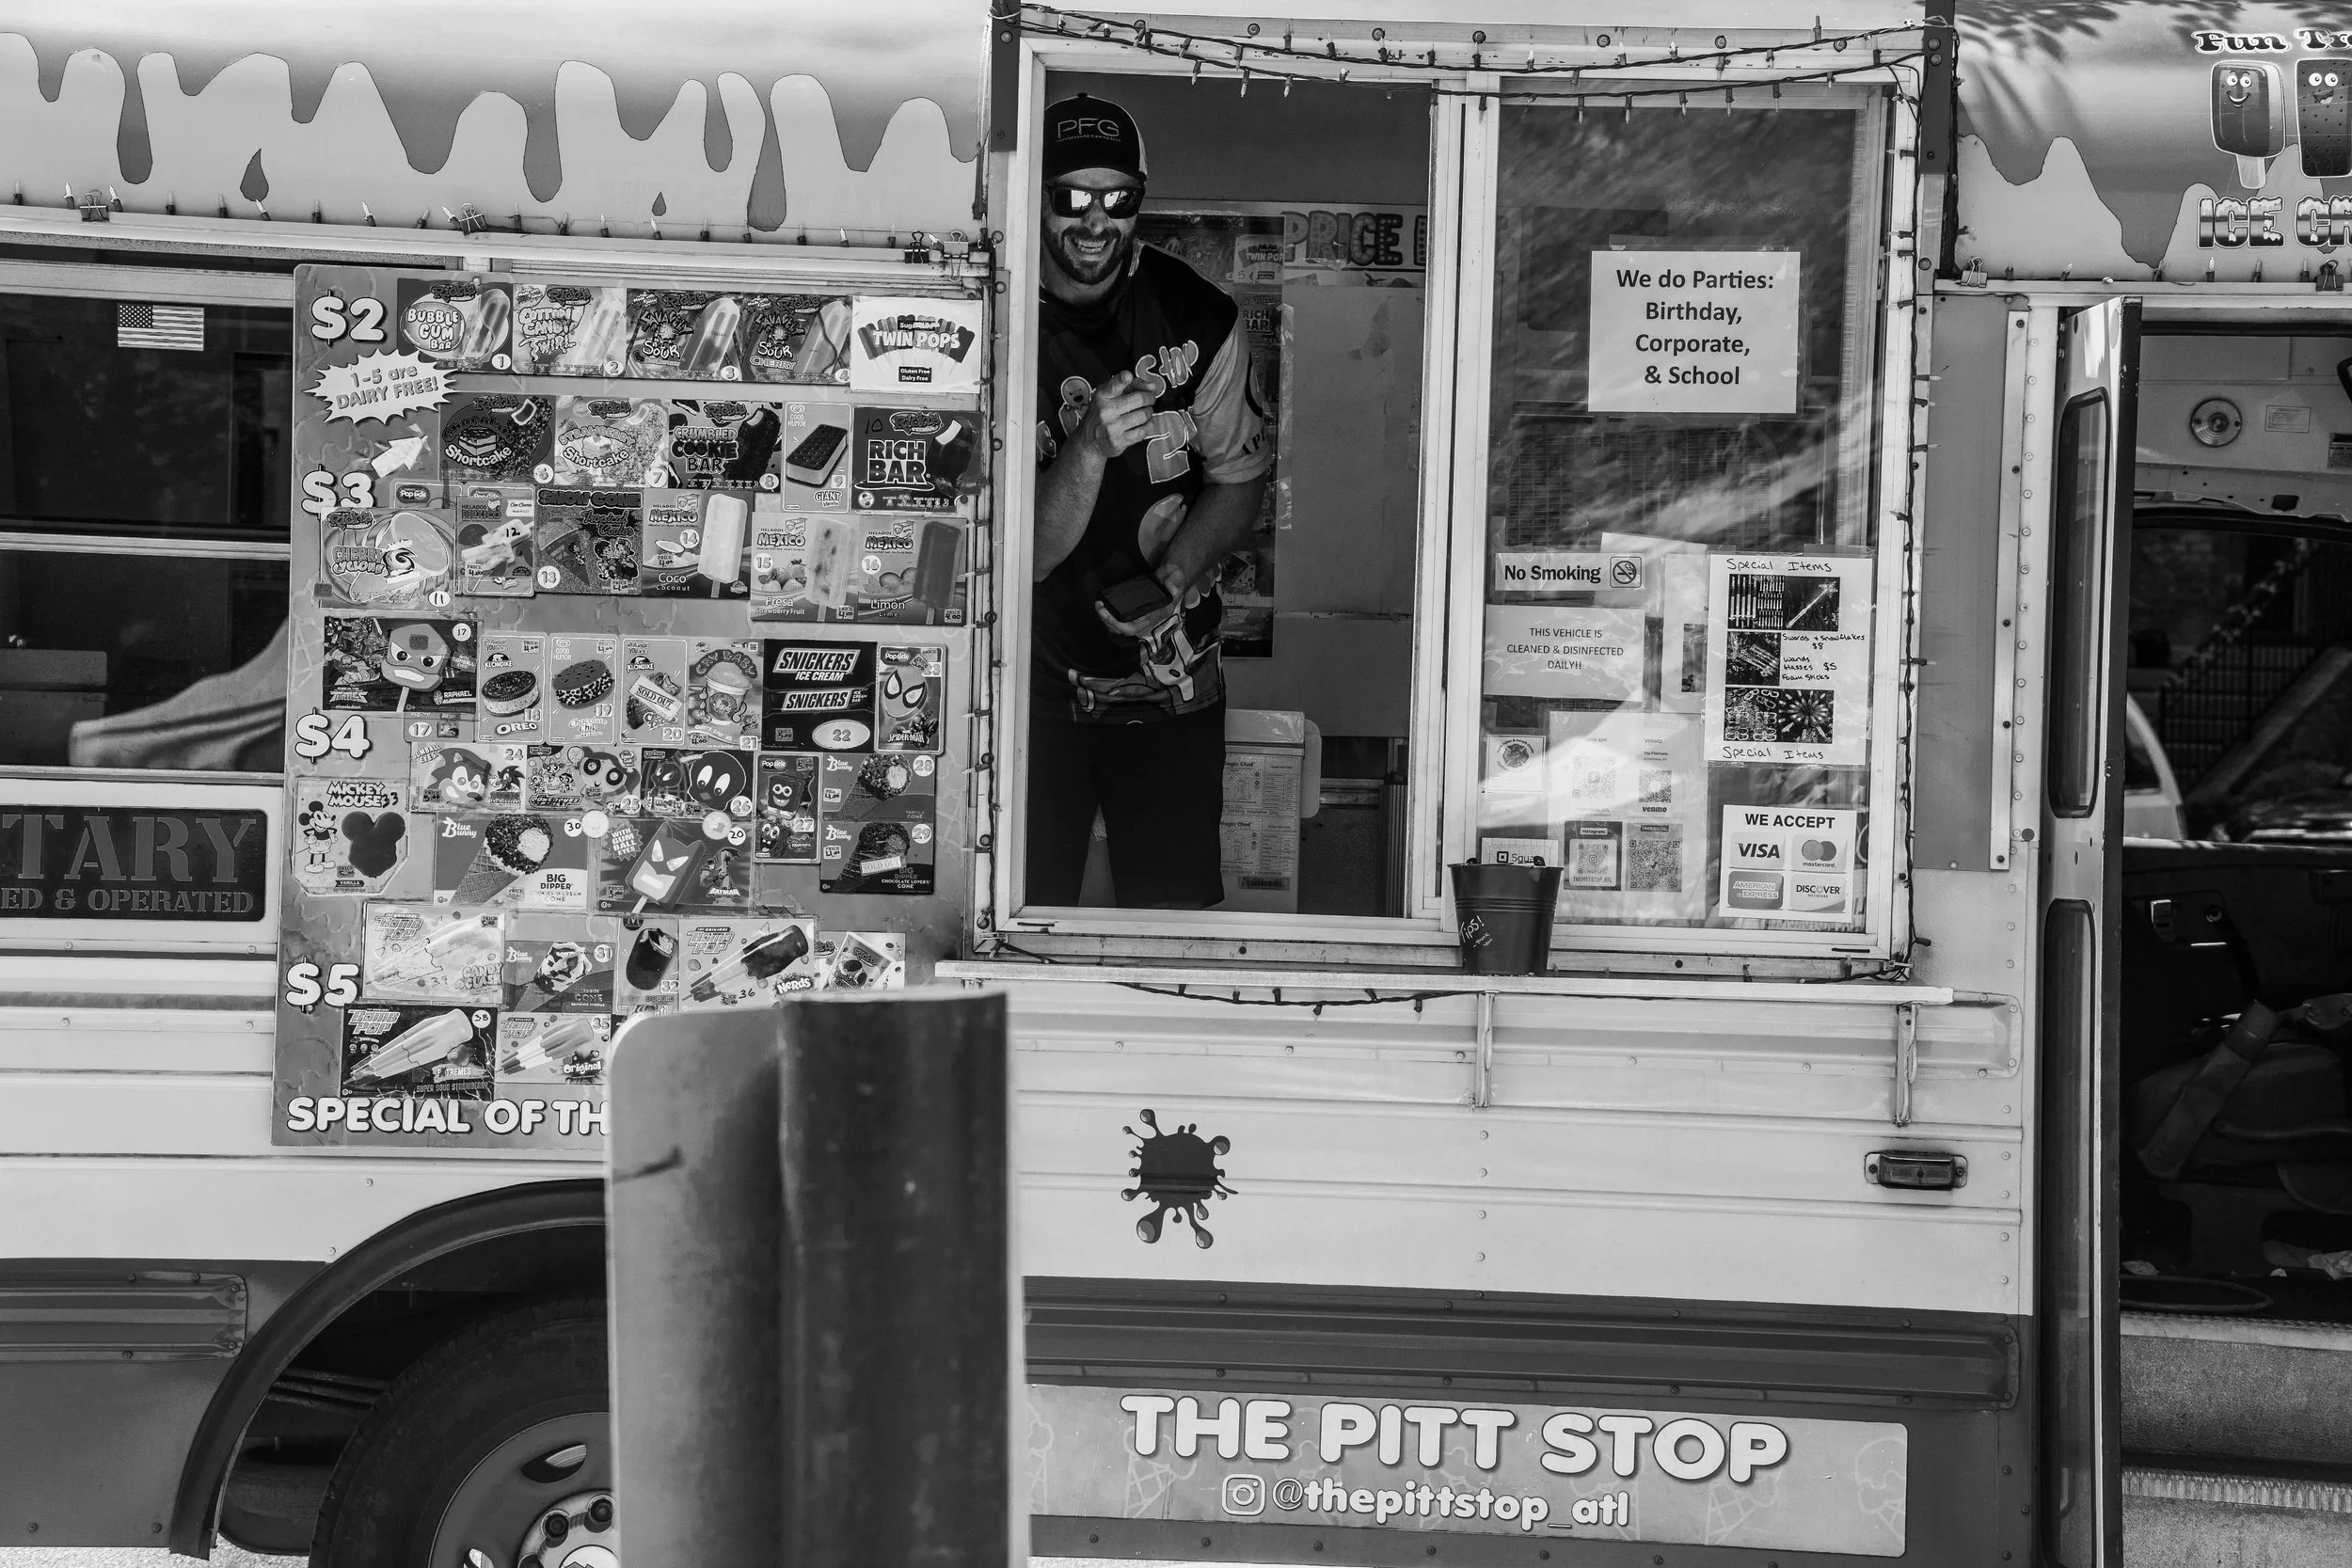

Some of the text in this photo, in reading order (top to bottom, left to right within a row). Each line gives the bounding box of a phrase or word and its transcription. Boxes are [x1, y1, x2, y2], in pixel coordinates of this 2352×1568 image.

[2193, 31, 2290, 53] Fun
[1057, 118, 1120, 138] PFG
[2198, 196, 2285, 248] ICE
[1280, 210, 1403, 266] PRICE
[1616, 269, 1773, 289] We do Parties:
[310, 289, 386, 347] $2
[407, 309, 458, 325] BUBBLE
[519, 307, 572, 324] COTTON
[1243, 310, 1270, 320] RICH
[1645, 302, 1742, 325] Birthday,
[419, 325, 453, 340] GUM
[523, 322, 570, 336] CANDY
[873, 331, 960, 348] TWIN POPS
[1635, 334, 1750, 356] Corporate,
[519, 336, 576, 361] TWIRL
[644, 341, 680, 358] SOUR
[758, 341, 793, 358] SOUR
[611, 363, 619, 374] 2
[750, 356, 796, 370] CHERRY
[350, 365, 418, 387] 1-5 are
[1645, 365, 1740, 385] & School
[335, 376, 438, 410] DAIRY FREE!
[558, 426, 636, 447] STRAWBERRY
[674, 427, 738, 441] CRUMBLED
[445, 445, 512, 467] Shortcake
[563, 446, 629, 467] Shortcake
[868, 439, 927, 460] RICH
[686, 457, 726, 473] BAR
[867, 459, 927, 484] BAR
[654, 471, 663, 483] 7
[765, 475, 774, 487] 8
[834, 476, 843, 487] 9
[301, 465, 373, 519] $3
[538, 490, 643, 508] SNOW CONE
[814, 491, 842, 502] GIANT
[461, 509, 501, 519] MEXICO
[648, 509, 698, 525] MEXICO
[682, 531, 697, 545] 14
[756, 532, 806, 547] MEXICO
[865, 535, 914, 550] MEXICO
[332, 546, 382, 562] CHERRY
[755, 557, 772, 569] 15
[864, 558, 880, 571] 16
[1726, 559, 1833, 573] Special Items
[542, 571, 556, 583] 13
[659, 572, 687, 584] Coco
[1504, 564, 1601, 584] No Smoking
[765, 596, 795, 607] Fresa
[870, 598, 905, 610] Limón
[1529, 627, 1602, 639] THIS VEHICLE IS
[1782, 633, 1809, 641] Swords
[1820, 633, 1866, 641] Snowflakes
[1506, 644, 1624, 657] CLEANED & DISINFECTED
[484, 661, 513, 670] KLONDIKE
[627, 663, 654, 673] KLONDIKE
[778, 650, 855, 672] SNICKERS
[1548, 660, 1582, 670] DAILY!!
[795, 672, 845, 682] ICE CREAM
[785, 691, 849, 710] SNICKERS
[527, 710, 541, 721] 18
[596, 704, 612, 716] 19
[294, 707, 372, 765] $4
[412, 723, 431, 736] 17
[496, 722, 538, 736] OREO
[662, 728, 681, 740] 20
[832, 729, 851, 741] 22
[741, 736, 756, 749] 21
[888, 734, 924, 742] SPIDER-MAN
[504, 748, 524, 761] 24
[1723, 746, 1824, 760] Special Items
[762, 760, 787, 768] Popsicle
[914, 759, 934, 772] 28
[326, 781, 385, 795] MICKEY
[327, 794, 384, 808] MOUSE
[621, 797, 640, 809] 25
[732, 800, 751, 813] 26
[566, 821, 581, 832] 30
[794, 819, 814, 832] 27
[1745, 814, 1836, 829] WE ACCEPT
[612, 828, 631, 838] WITH
[612, 834, 635, 845] GUM
[912, 827, 932, 840] 29
[2, 814, 257, 883] TARY
[612, 841, 637, 850] BALL
[617, 847, 636, 856] EYES
[1737, 843, 1780, 858] VISA
[547, 874, 566, 883] BIG
[1733, 881, 1775, 891] AMERICAN
[1796, 884, 1840, 895] DISCOVER
[0, 888, 255, 914] ED & OPERATED
[1742, 890, 1778, 899] EXPRESS
[1460, 915, 1485, 942] Tips!
[596, 947, 611, 959] 31
[462, 962, 503, 977] CANDY
[285, 955, 358, 1013] $5
[739, 989, 755, 999] 36
[592, 1017, 610, 1030] 35
[563, 1060, 602, 1074] Original
[417, 1082, 488, 1092] SUPER SOUR STRAWBERRY
[287, 1096, 471, 1133] SPECIAL
[484, 1099, 546, 1135] OF
[1120, 1395, 1788, 1483] THE PITT STOP
[1272, 1477, 1629, 1531] @thepittstop_atl
